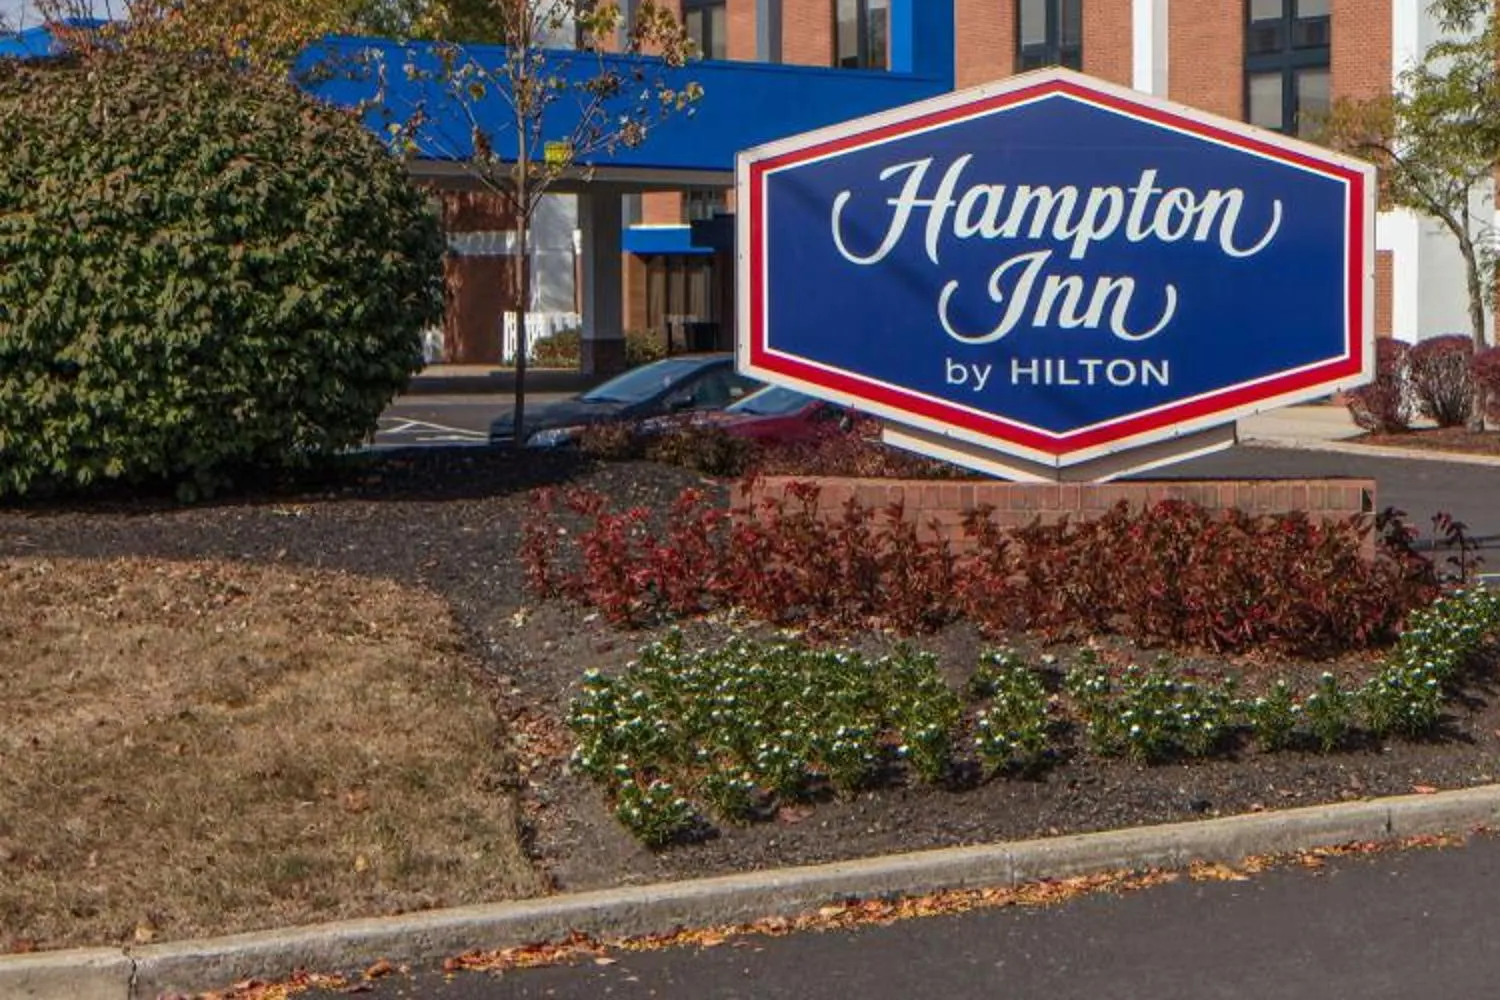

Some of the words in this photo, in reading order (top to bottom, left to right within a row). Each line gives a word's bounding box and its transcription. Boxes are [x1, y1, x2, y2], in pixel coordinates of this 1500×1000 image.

[831, 153, 1283, 265] Hampton
[938, 249, 1177, 344] Inn
[946, 357, 992, 392] by
[1011, 359, 1169, 386] HILTON
